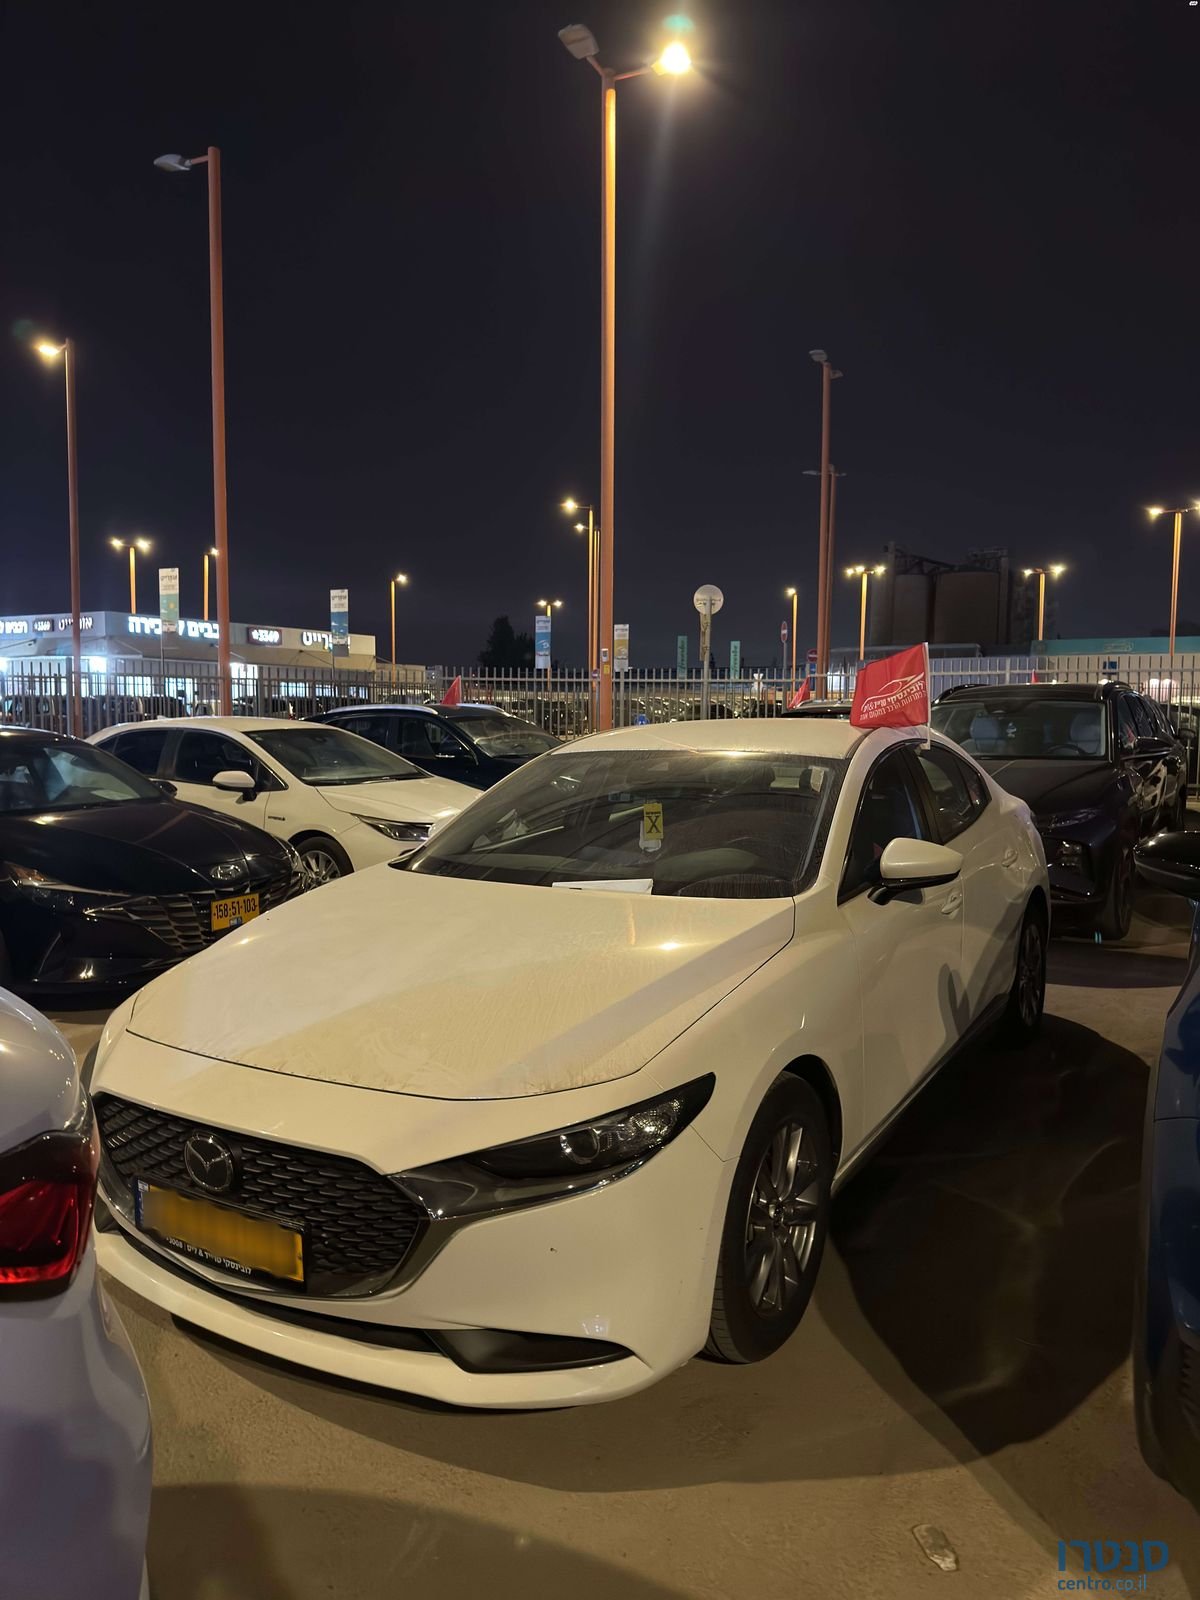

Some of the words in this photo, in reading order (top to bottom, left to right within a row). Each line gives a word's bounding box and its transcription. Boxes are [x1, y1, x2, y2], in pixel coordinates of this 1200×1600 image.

[128, 615, 185, 637] לכירה
[187, 620, 219, 639] כבים
[645, 815, 662, 834] X
